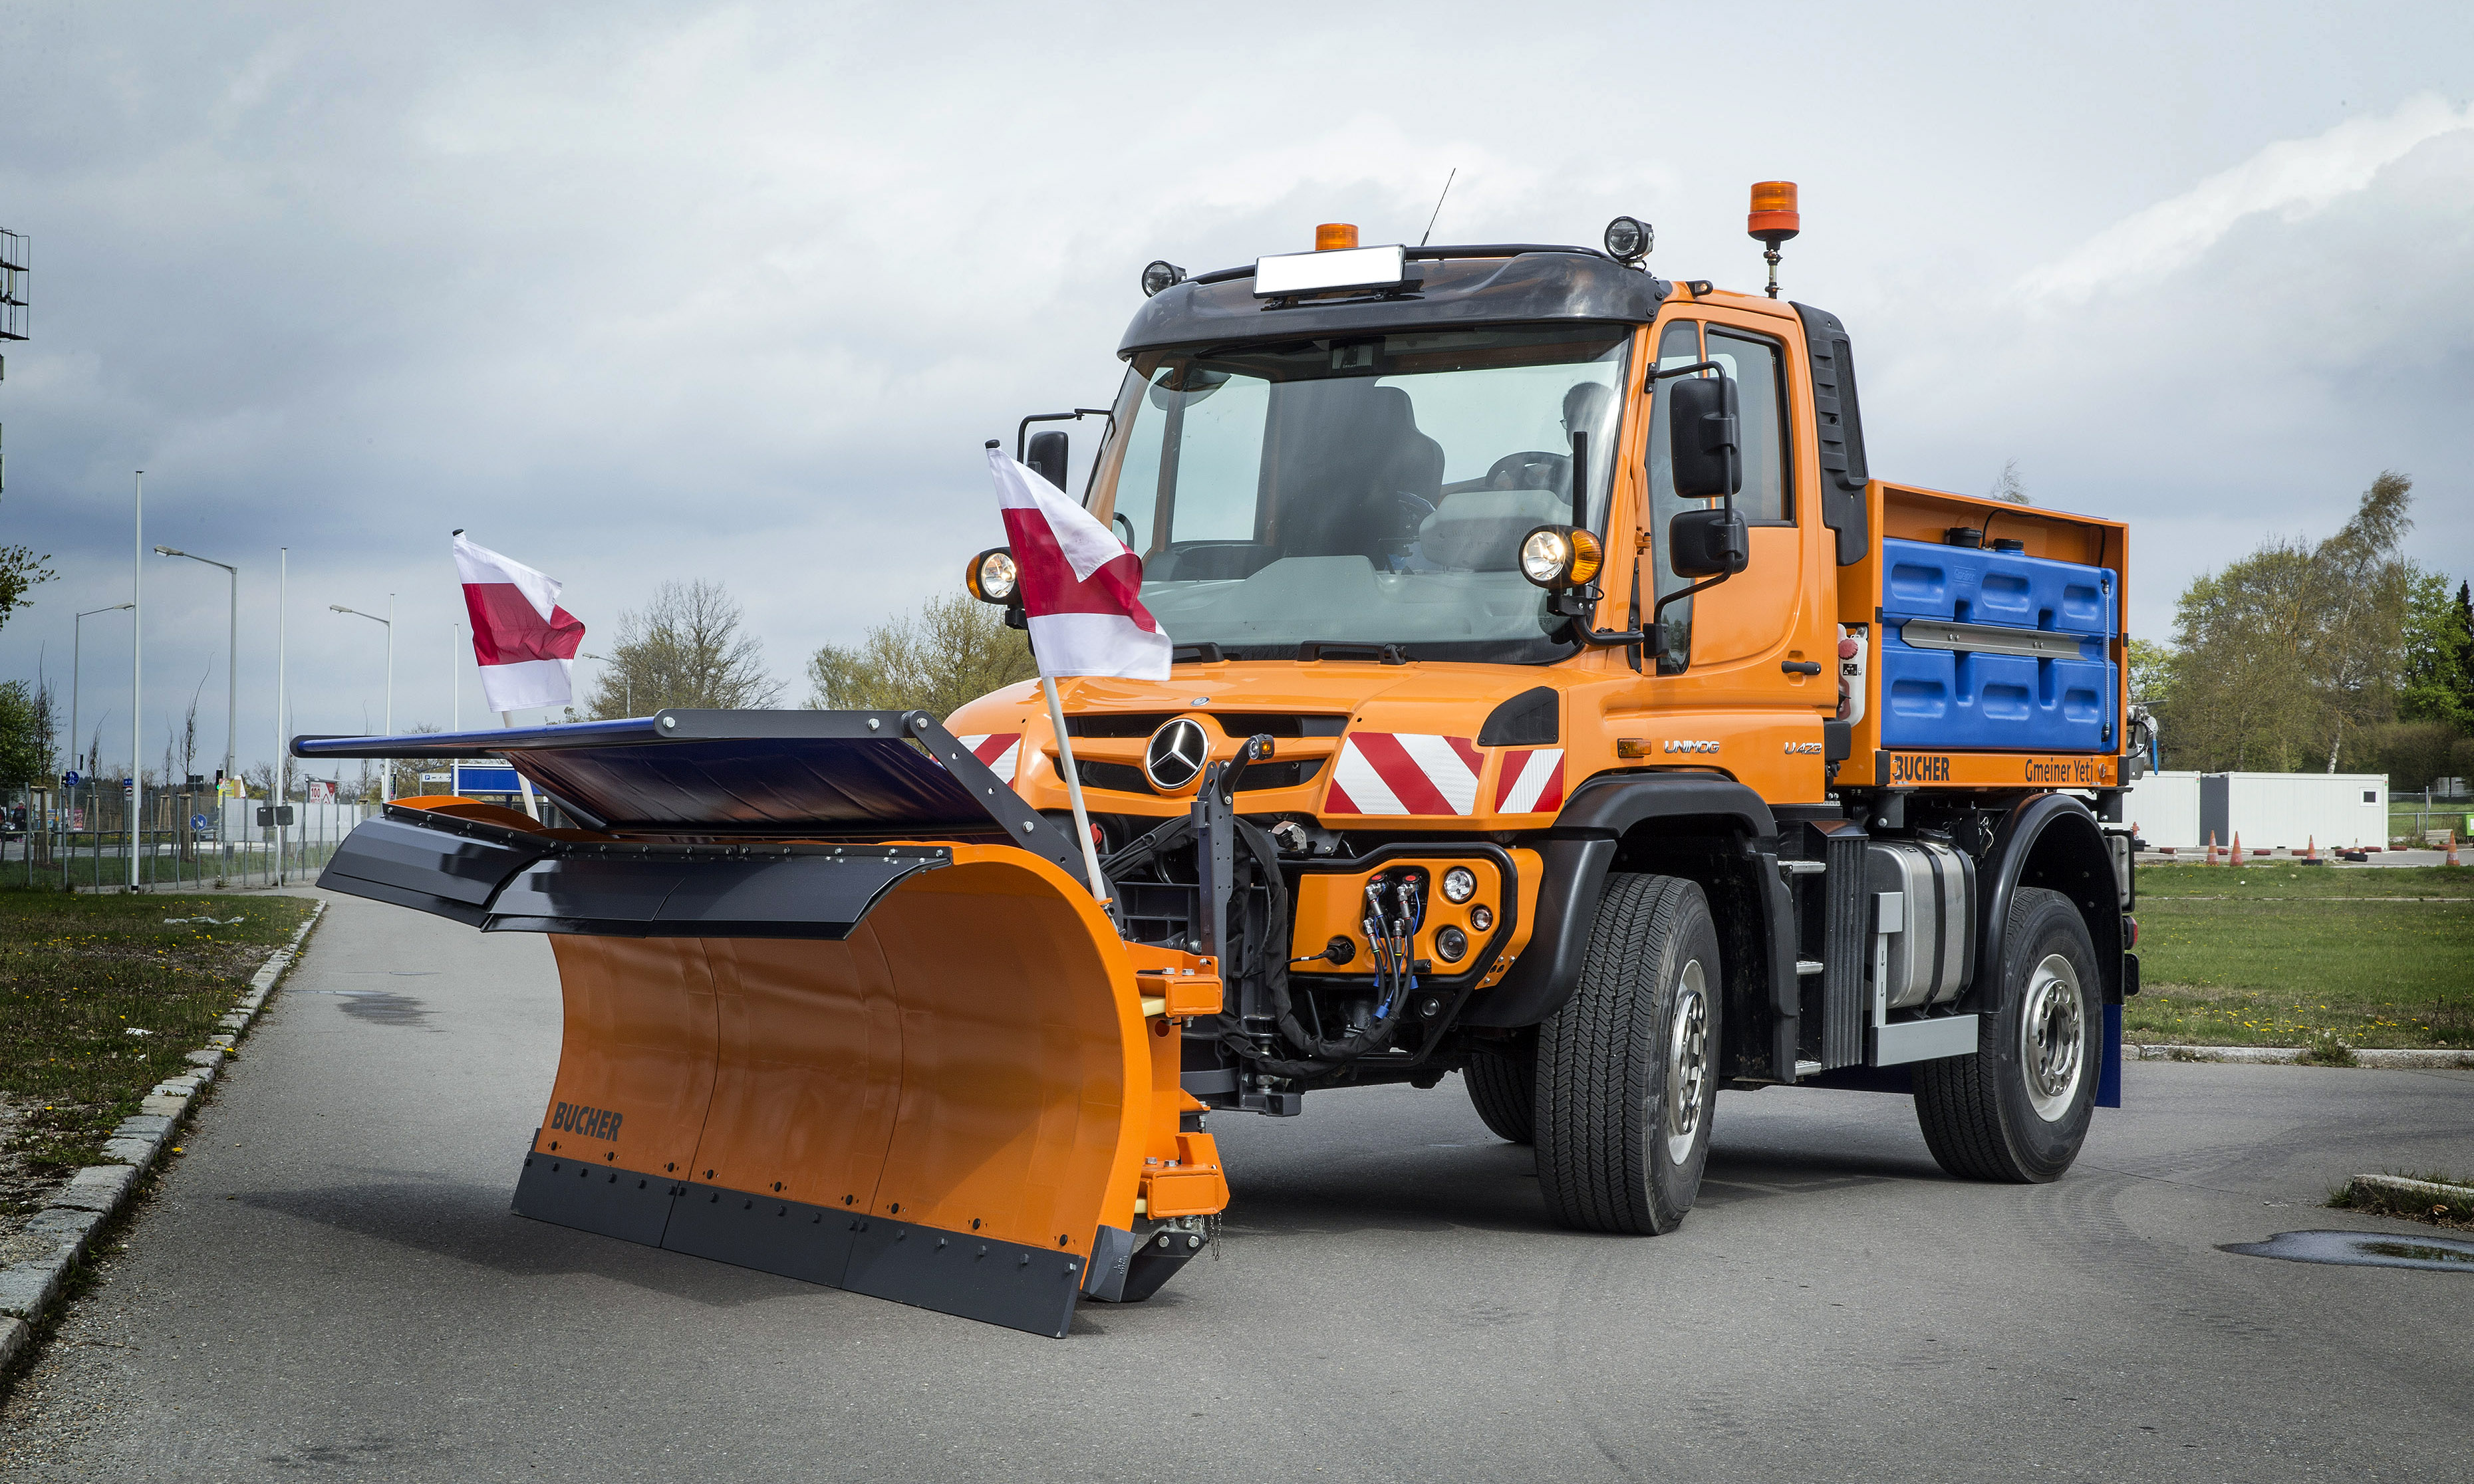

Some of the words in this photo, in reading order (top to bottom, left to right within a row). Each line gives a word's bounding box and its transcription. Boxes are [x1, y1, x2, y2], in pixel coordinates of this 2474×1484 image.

[1665, 740, 1720, 753] UNIMOG
[1785, 741, 1796, 755] U
[1796, 743, 1822, 755] 423
[1894, 755, 1950, 781] BUCHER
[2025, 757, 2071, 782] Gmeiner
[2074, 757, 2094, 782] Yeti
[311, 788, 321, 798] 100
[551, 1101, 623, 1142] BUCHER
